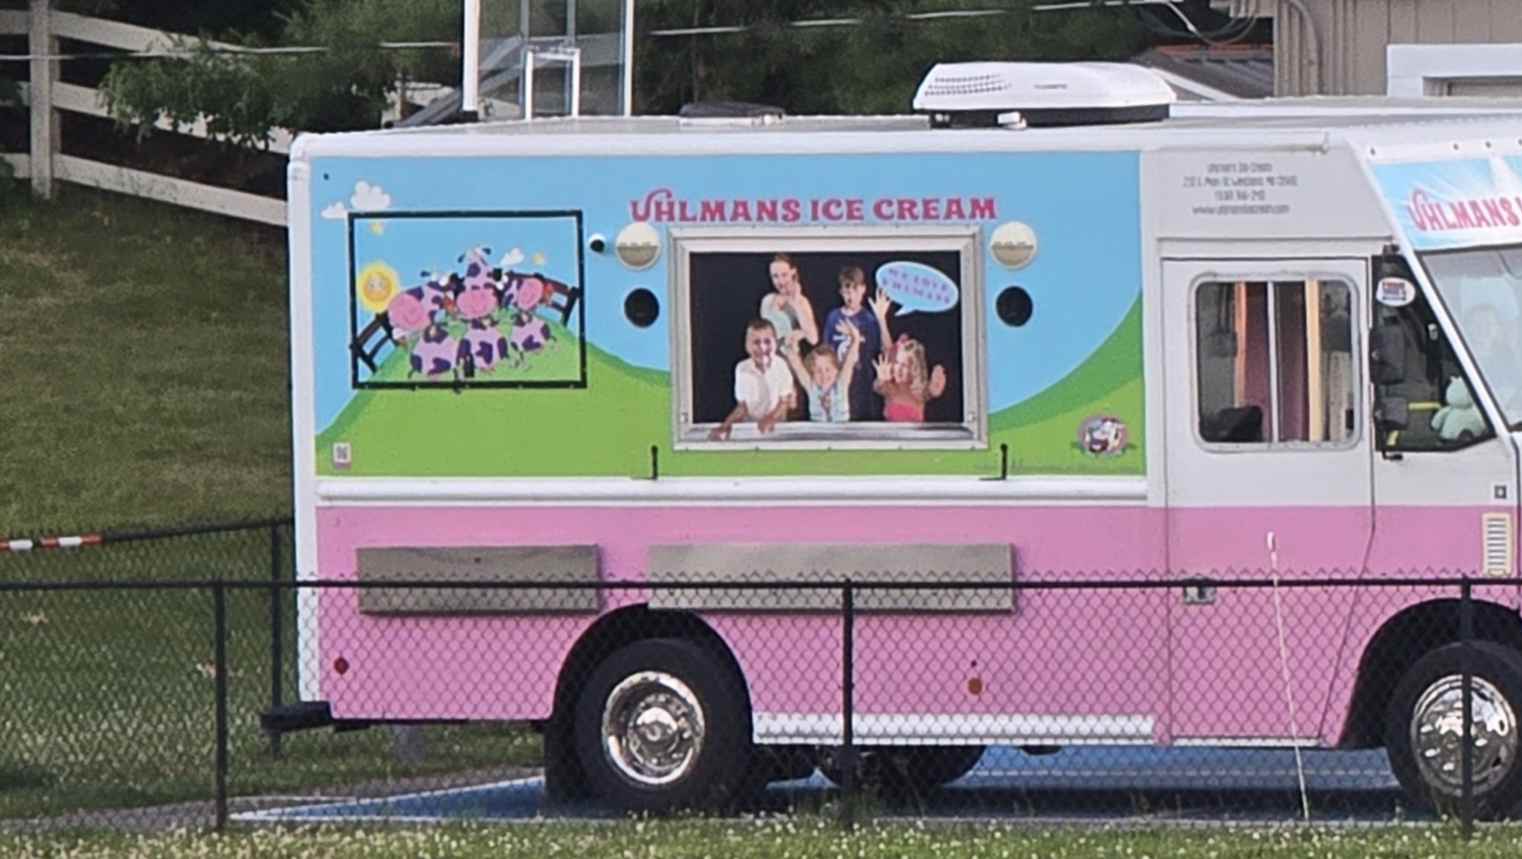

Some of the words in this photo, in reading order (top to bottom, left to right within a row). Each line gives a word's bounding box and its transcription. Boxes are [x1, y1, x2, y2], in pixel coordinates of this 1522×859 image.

[629, 188, 800, 223] UHLMANS
[810, 199, 865, 222] ICE
[873, 198, 998, 222] CREAM
[1407, 187, 1521, 231] UHLMANS
